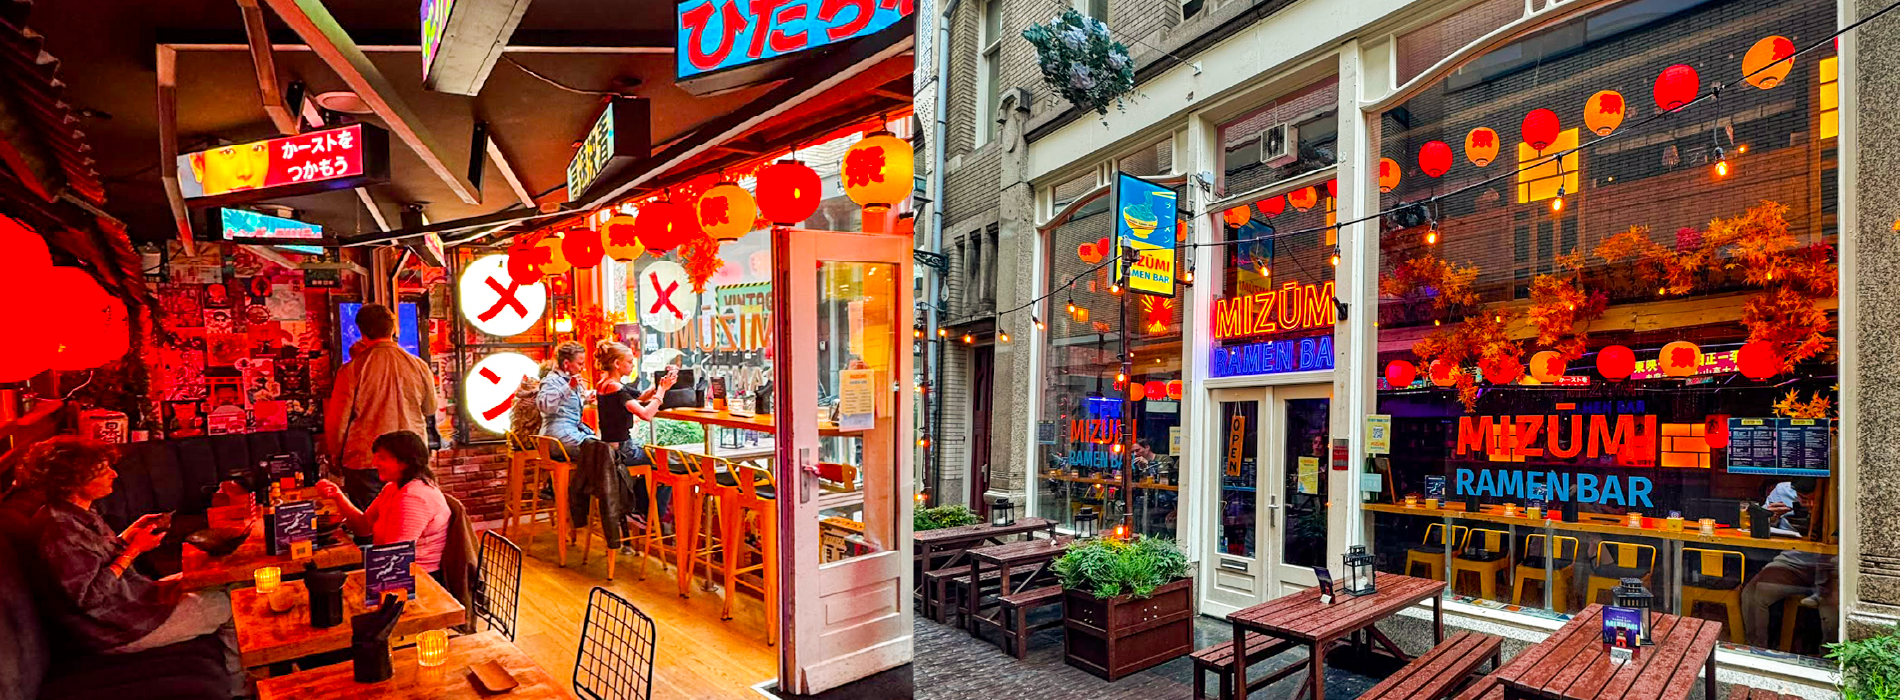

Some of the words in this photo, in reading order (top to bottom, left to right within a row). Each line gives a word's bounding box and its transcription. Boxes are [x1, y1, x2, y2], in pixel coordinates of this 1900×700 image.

[281, 130, 353, 159] かーストを
[287, 157, 348, 181] つかもう
[1130, 268, 1151, 280] MEN
[1152, 272, 1170, 284] BAR
[1133, 253, 1171, 273] ZŪMI
[1214, 339, 1294, 376] RAMEN
[1229, 418, 1240, 473] OPEN
[1456, 402, 1657, 461] MIZŪMI
[1068, 450, 1109, 468] RAMEN
[1456, 468, 1570, 502] RAMEN
[1576, 472, 1654, 508] BAR
